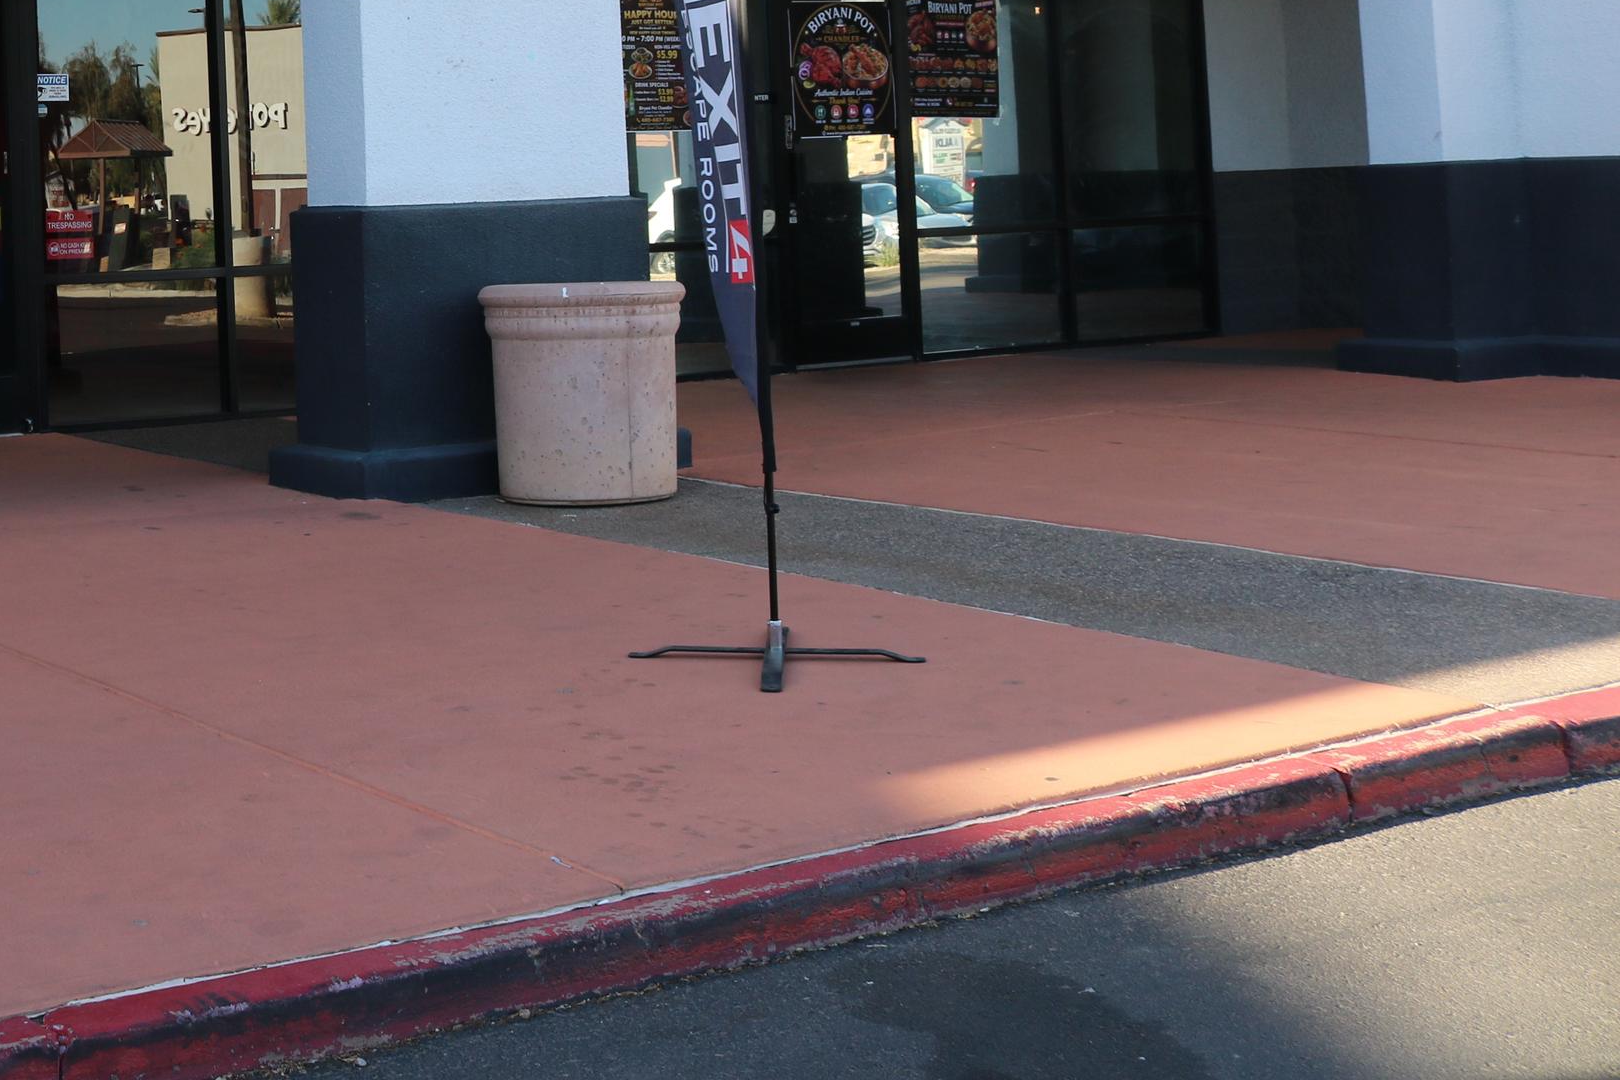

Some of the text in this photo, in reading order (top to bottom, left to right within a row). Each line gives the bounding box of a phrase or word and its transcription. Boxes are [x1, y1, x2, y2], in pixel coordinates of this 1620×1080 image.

[927, 1, 973, 14] BIRYANI POT
[623, 10, 651, 19] HAPPY
[807, 7, 876, 34] BIRYANI POT
[656, 50, 678, 59] $5.99
[37, 76, 67, 84] NOTICE
[64, 212, 75, 221] NO
[699, 157, 720, 274] ROOMS
[47, 221, 93, 230] TRESPASSING
